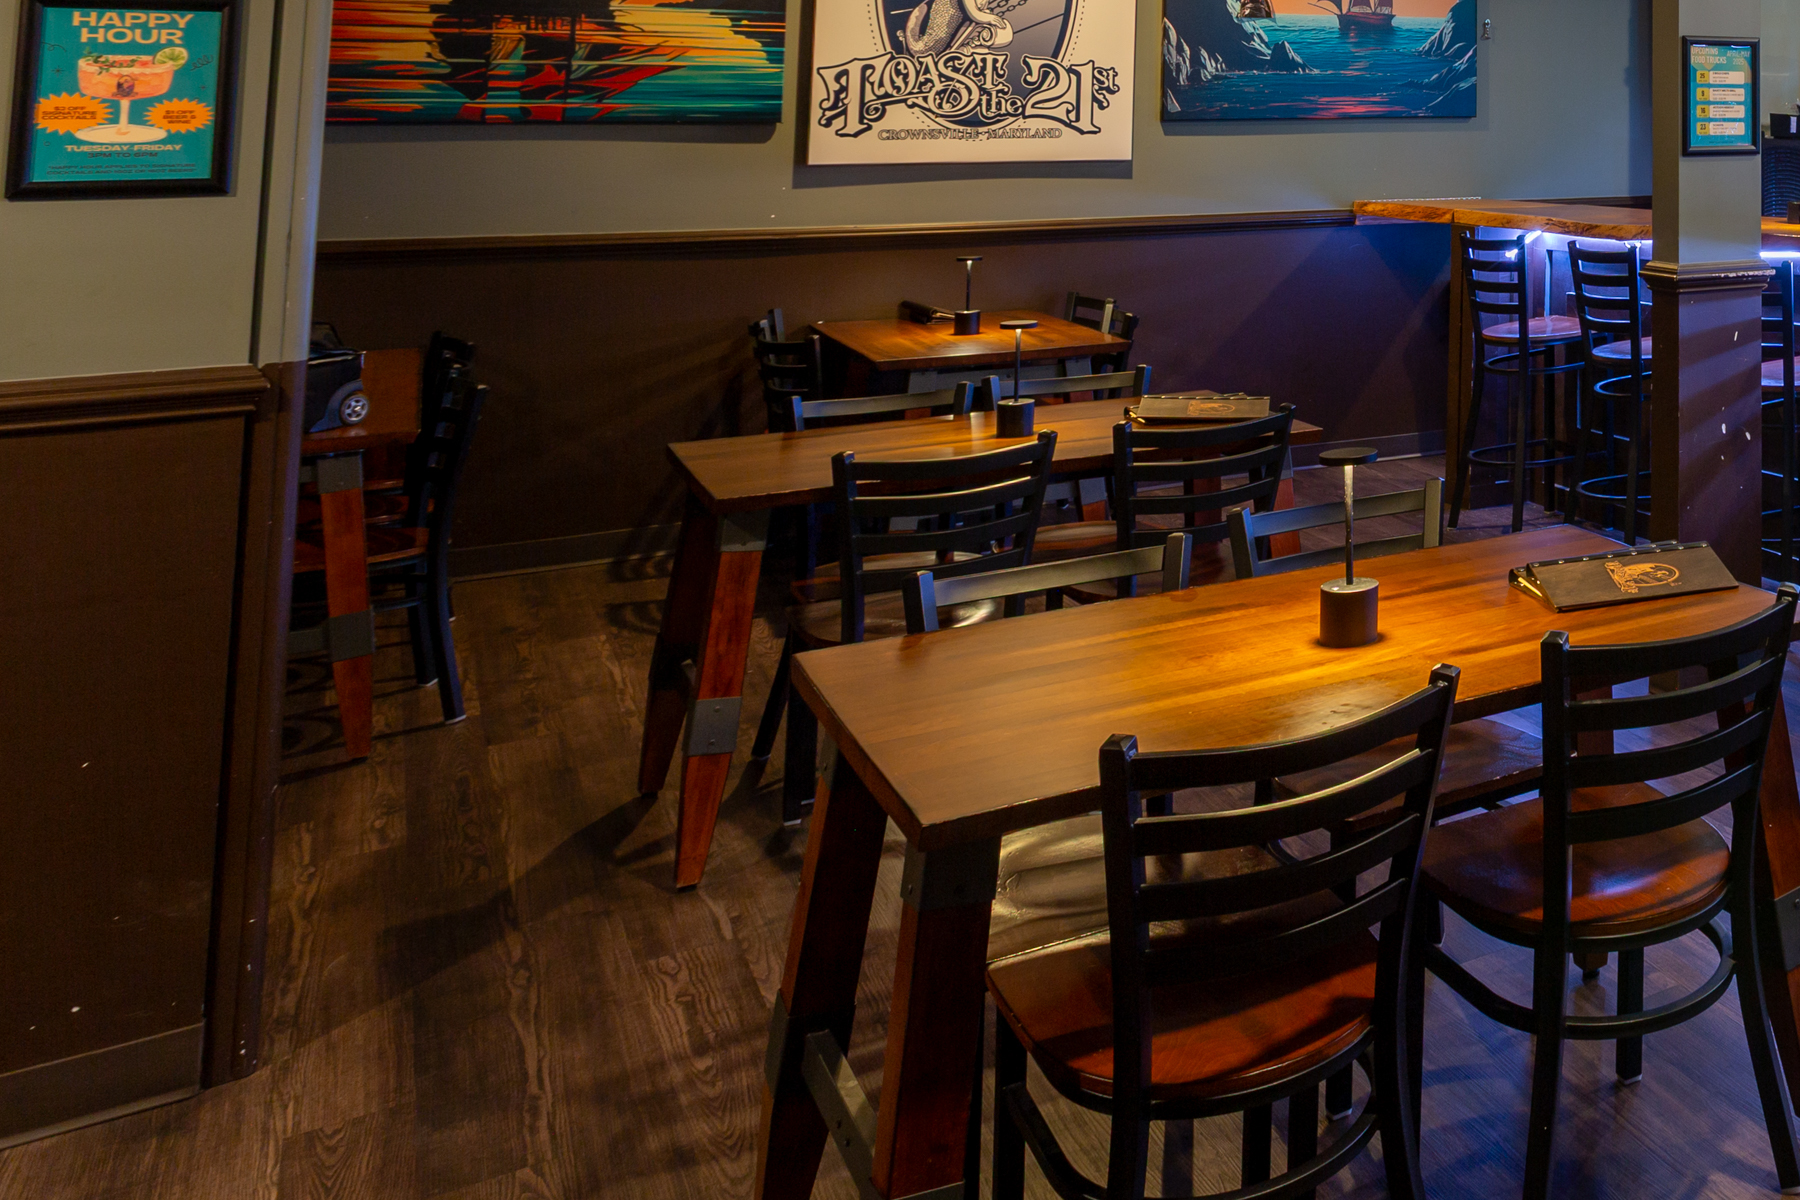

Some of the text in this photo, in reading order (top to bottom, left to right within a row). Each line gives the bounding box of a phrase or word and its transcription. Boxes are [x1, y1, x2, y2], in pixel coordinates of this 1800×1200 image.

[72, 11, 194, 28] HAPPY
[80, 28, 184, 44] HOUR
[1691, 47, 1718, 55] UPCOMING
[1707, 56, 1727, 64] TRUCKS
[817, 51, 1009, 137] TOAST
[979, 90, 1023, 119] the
[878, 127, 1062, 141] CROWNSVILLE MARYLAND
